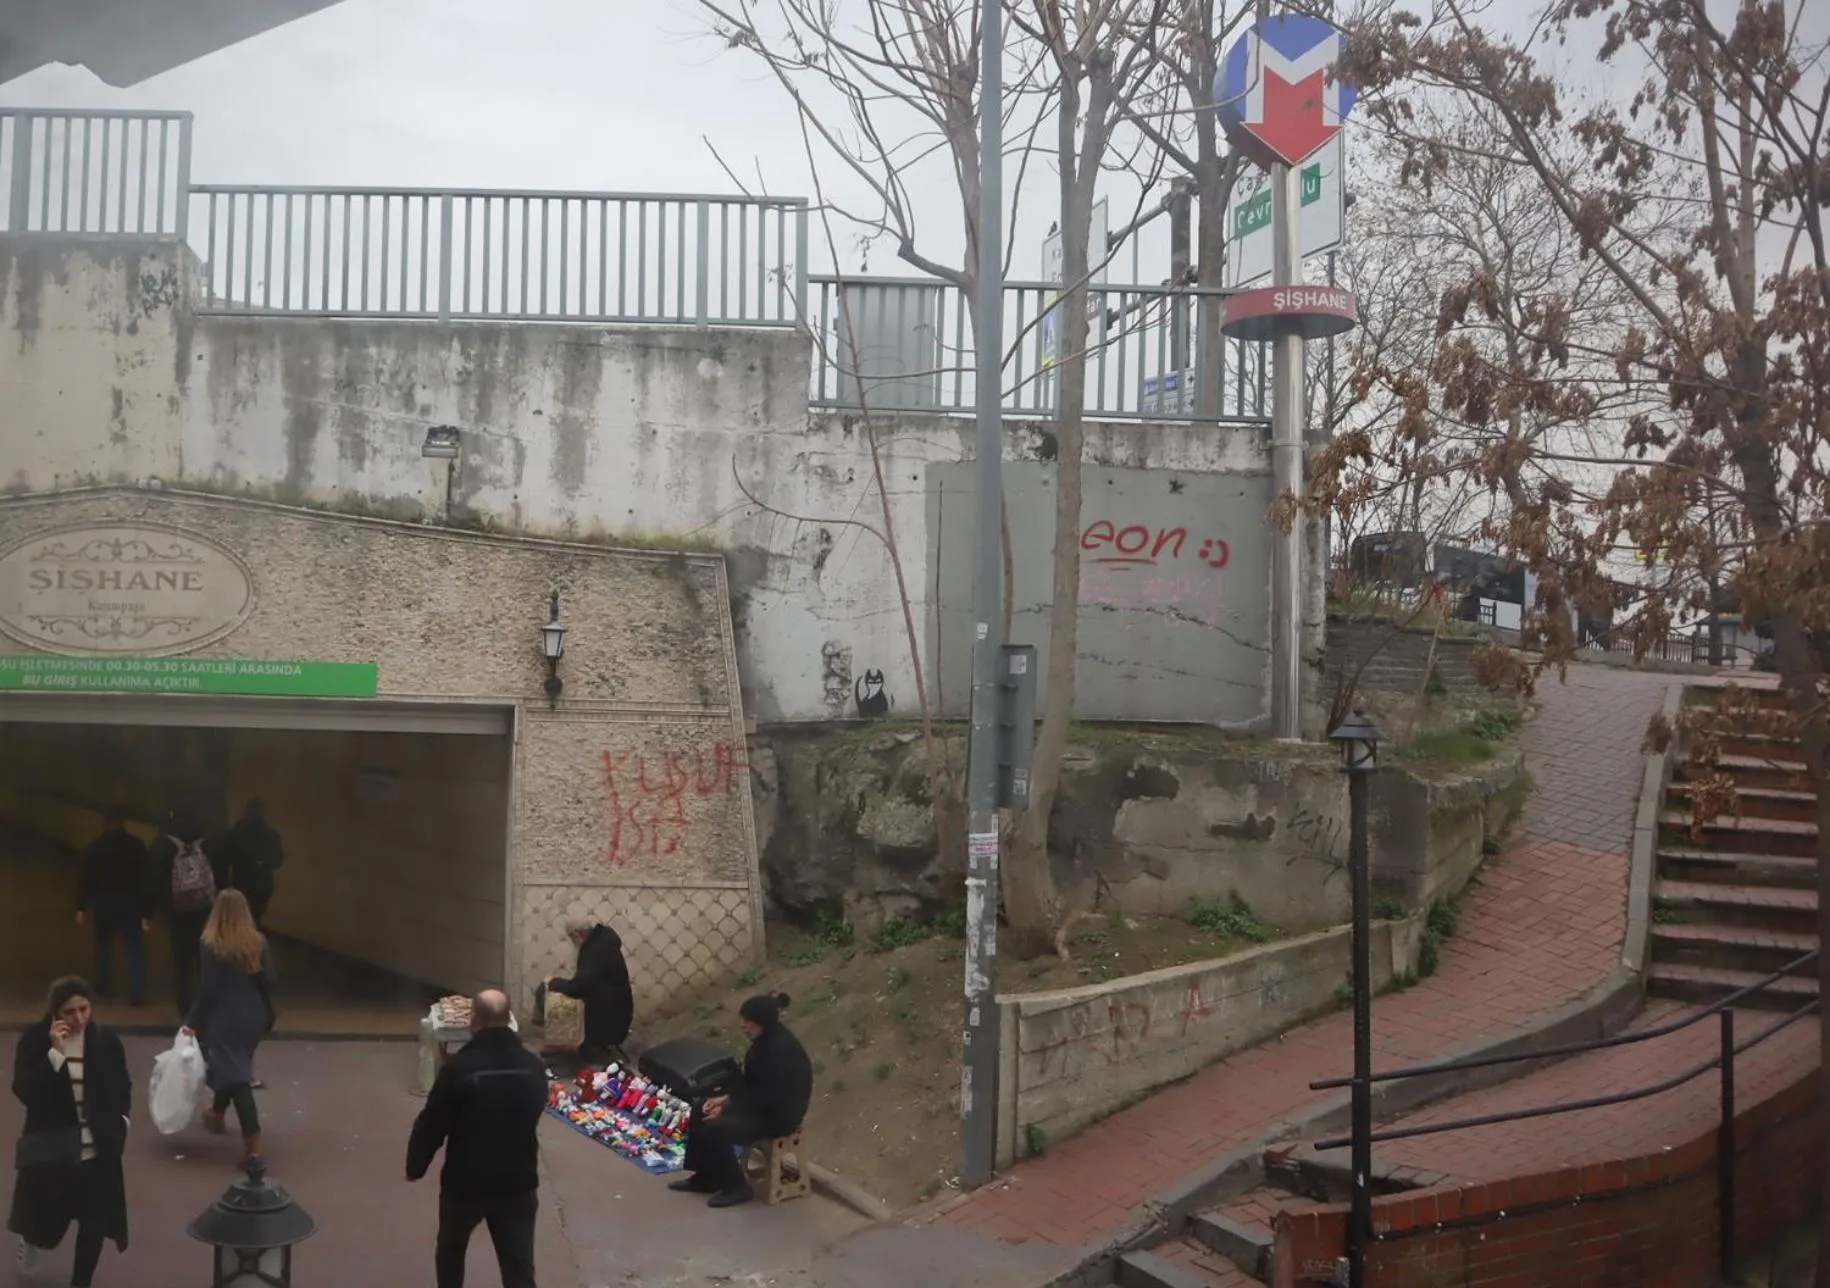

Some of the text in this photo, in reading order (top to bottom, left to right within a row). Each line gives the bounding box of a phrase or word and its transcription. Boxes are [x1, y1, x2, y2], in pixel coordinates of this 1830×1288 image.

[1273, 290, 1347, 311] ŞİŞHANE
[181, 661, 237, 674] SAATLERİ
[239, 663, 303, 675] ARASINDA
